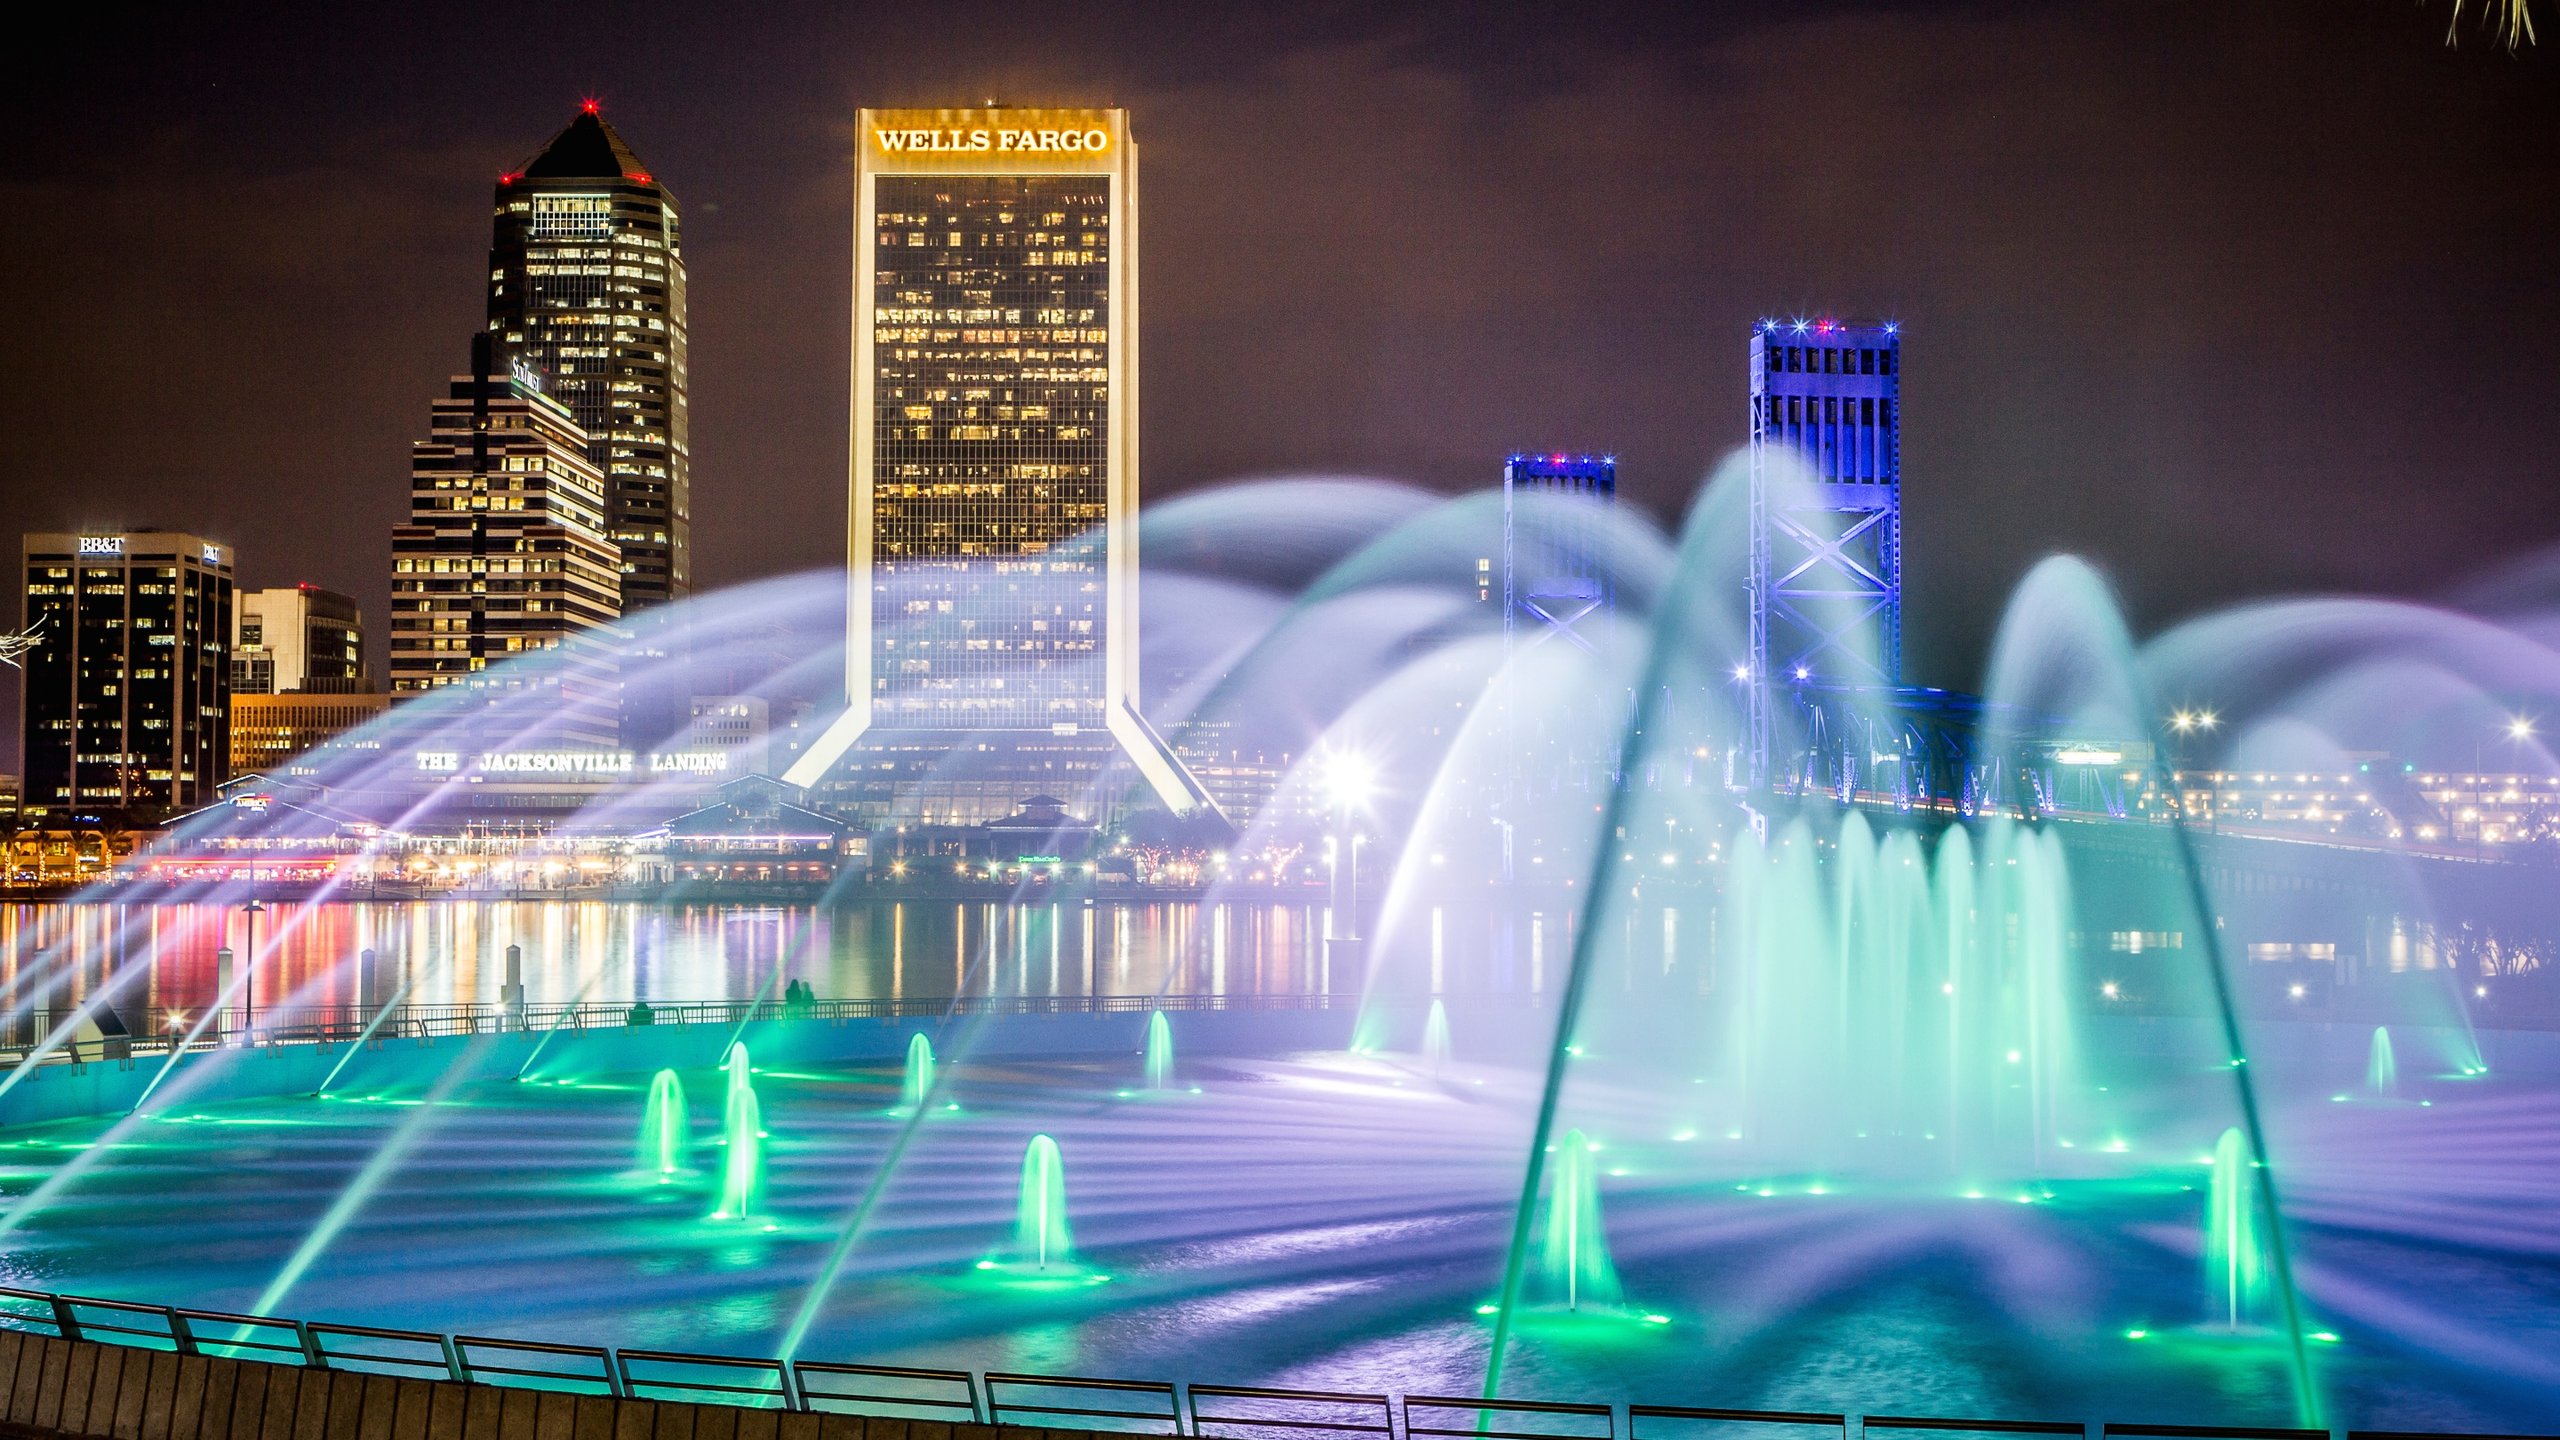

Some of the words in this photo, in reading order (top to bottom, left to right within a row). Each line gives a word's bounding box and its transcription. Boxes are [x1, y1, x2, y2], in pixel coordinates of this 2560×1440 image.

[876, 130, 990, 151] WELLS
[998, 130, 1107, 151] FARGO
[79, 537, 124, 553] BB&T
[417, 752, 457, 770] THE
[479, 752, 632, 772] JACKSONVILLE
[651, 752, 727, 772] LANDING
